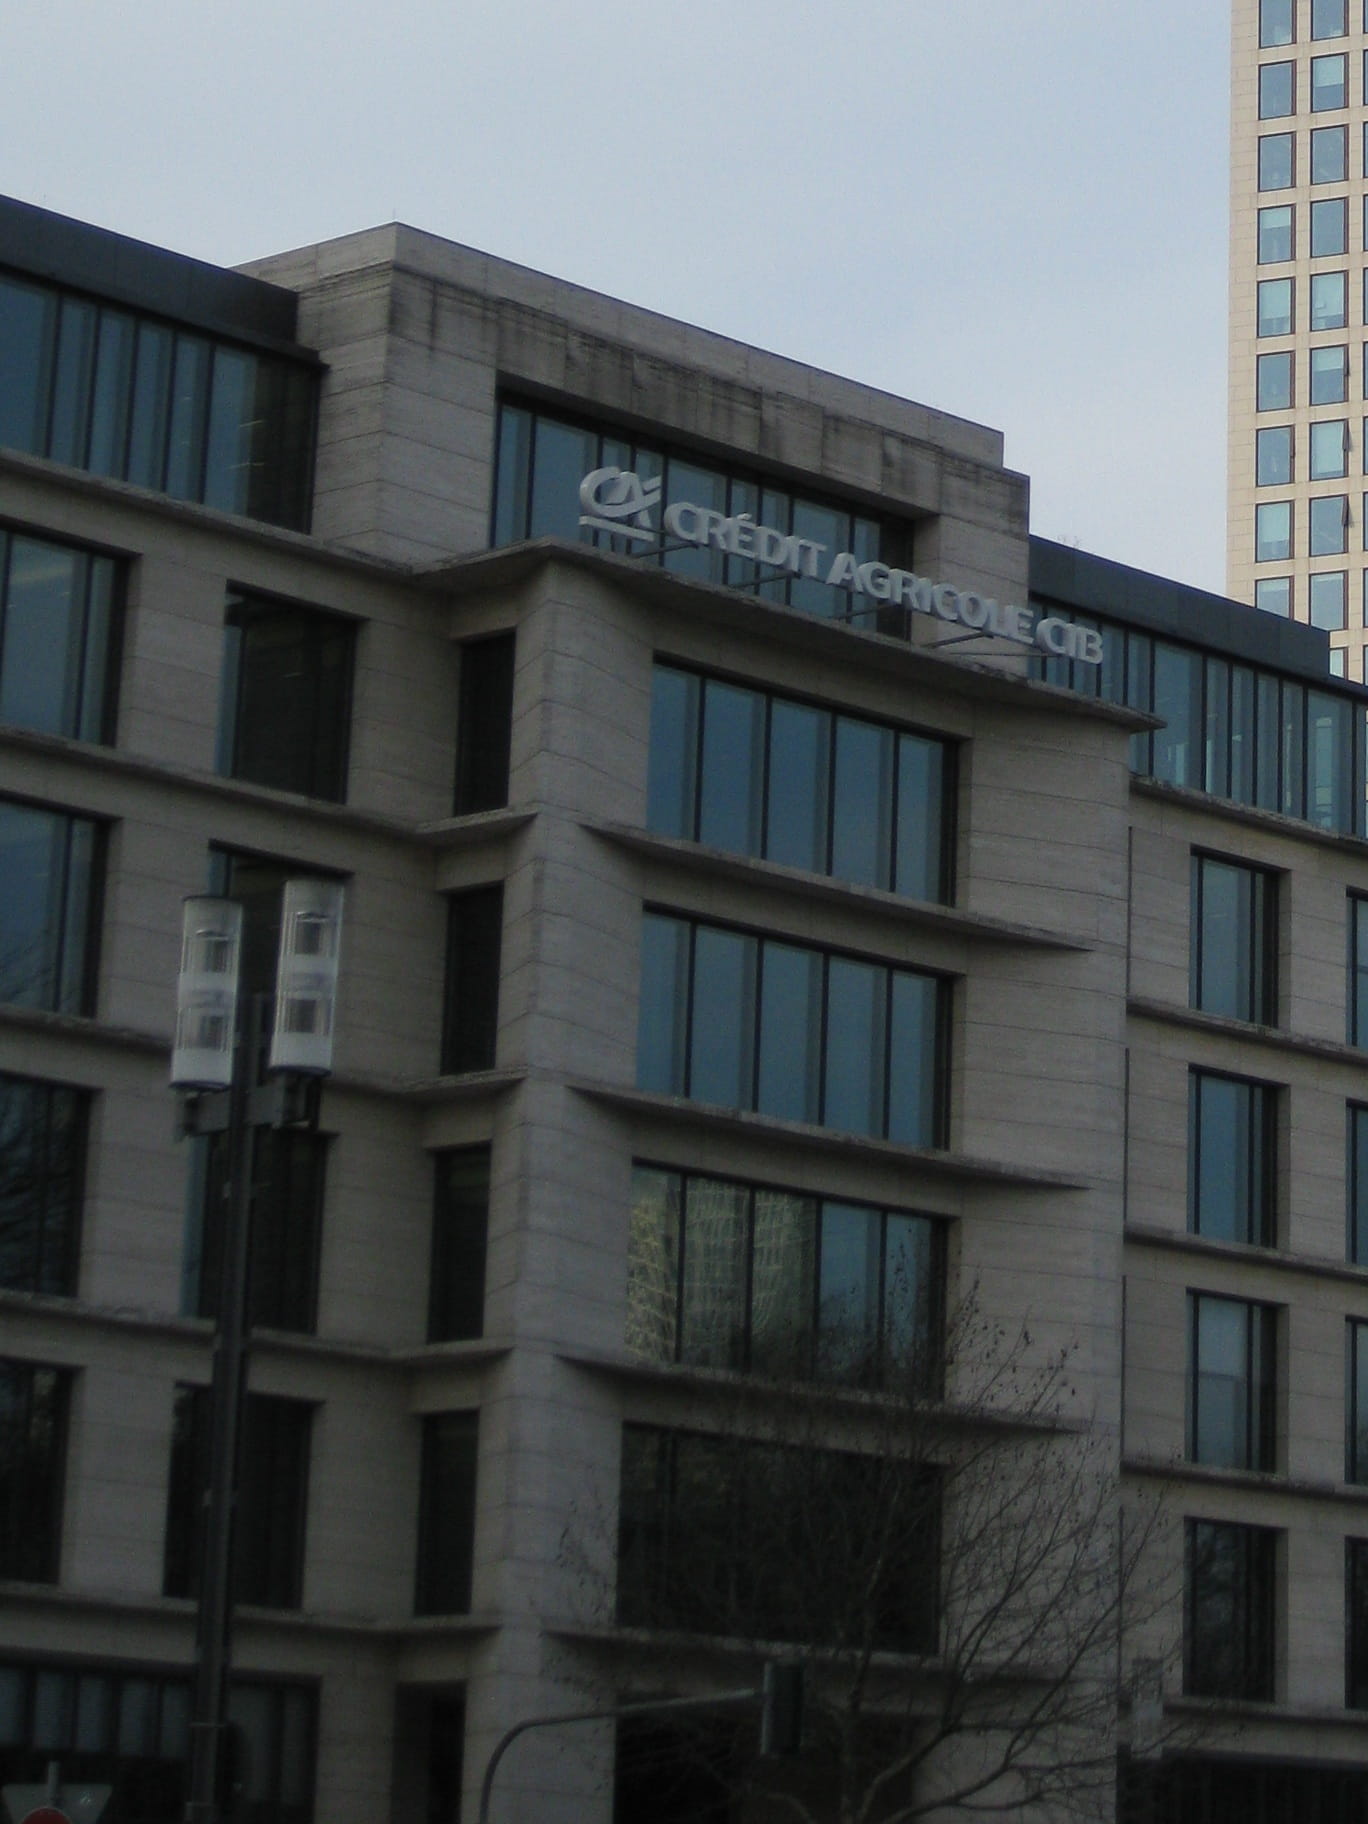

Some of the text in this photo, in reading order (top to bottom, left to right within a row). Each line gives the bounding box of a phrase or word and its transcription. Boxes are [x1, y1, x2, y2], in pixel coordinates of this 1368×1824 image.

[664, 502, 828, 576] CRÉDIT
[826, 552, 1035, 644] AGRICOLE
[1036, 617, 1103, 665] CIB
